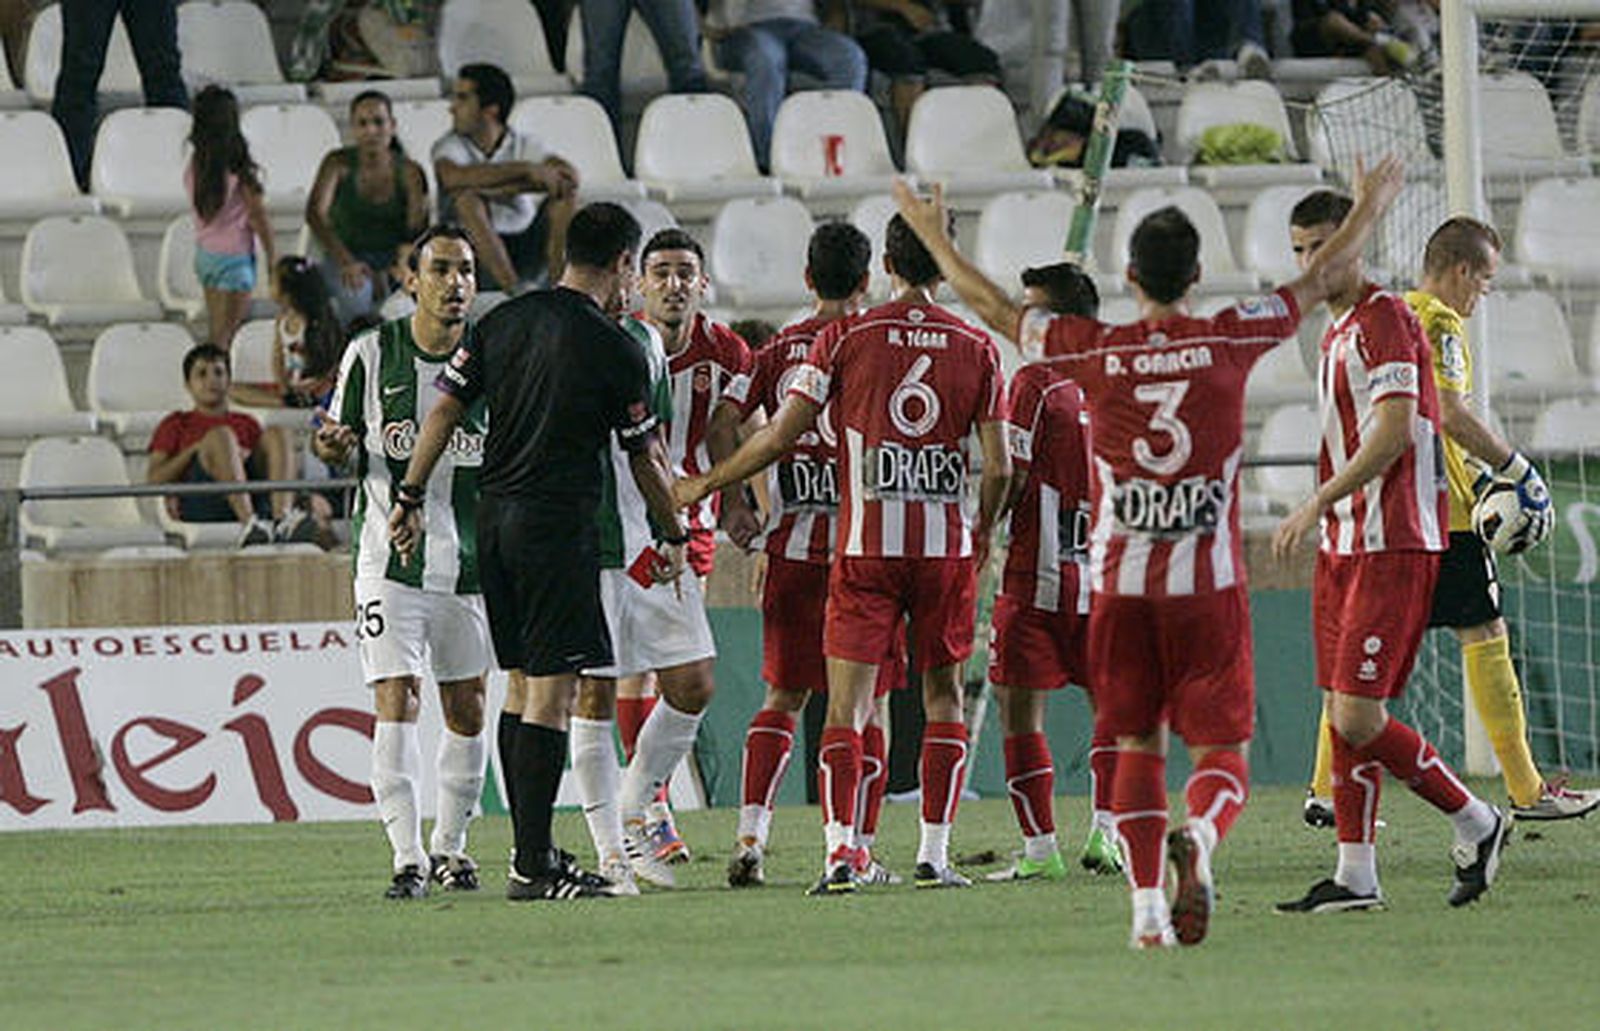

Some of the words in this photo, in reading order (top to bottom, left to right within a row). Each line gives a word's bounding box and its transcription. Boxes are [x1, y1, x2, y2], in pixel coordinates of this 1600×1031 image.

[889, 354, 941, 437] 6
[1132, 379, 1193, 476] 3
[878, 447, 963, 494] DRAPS
